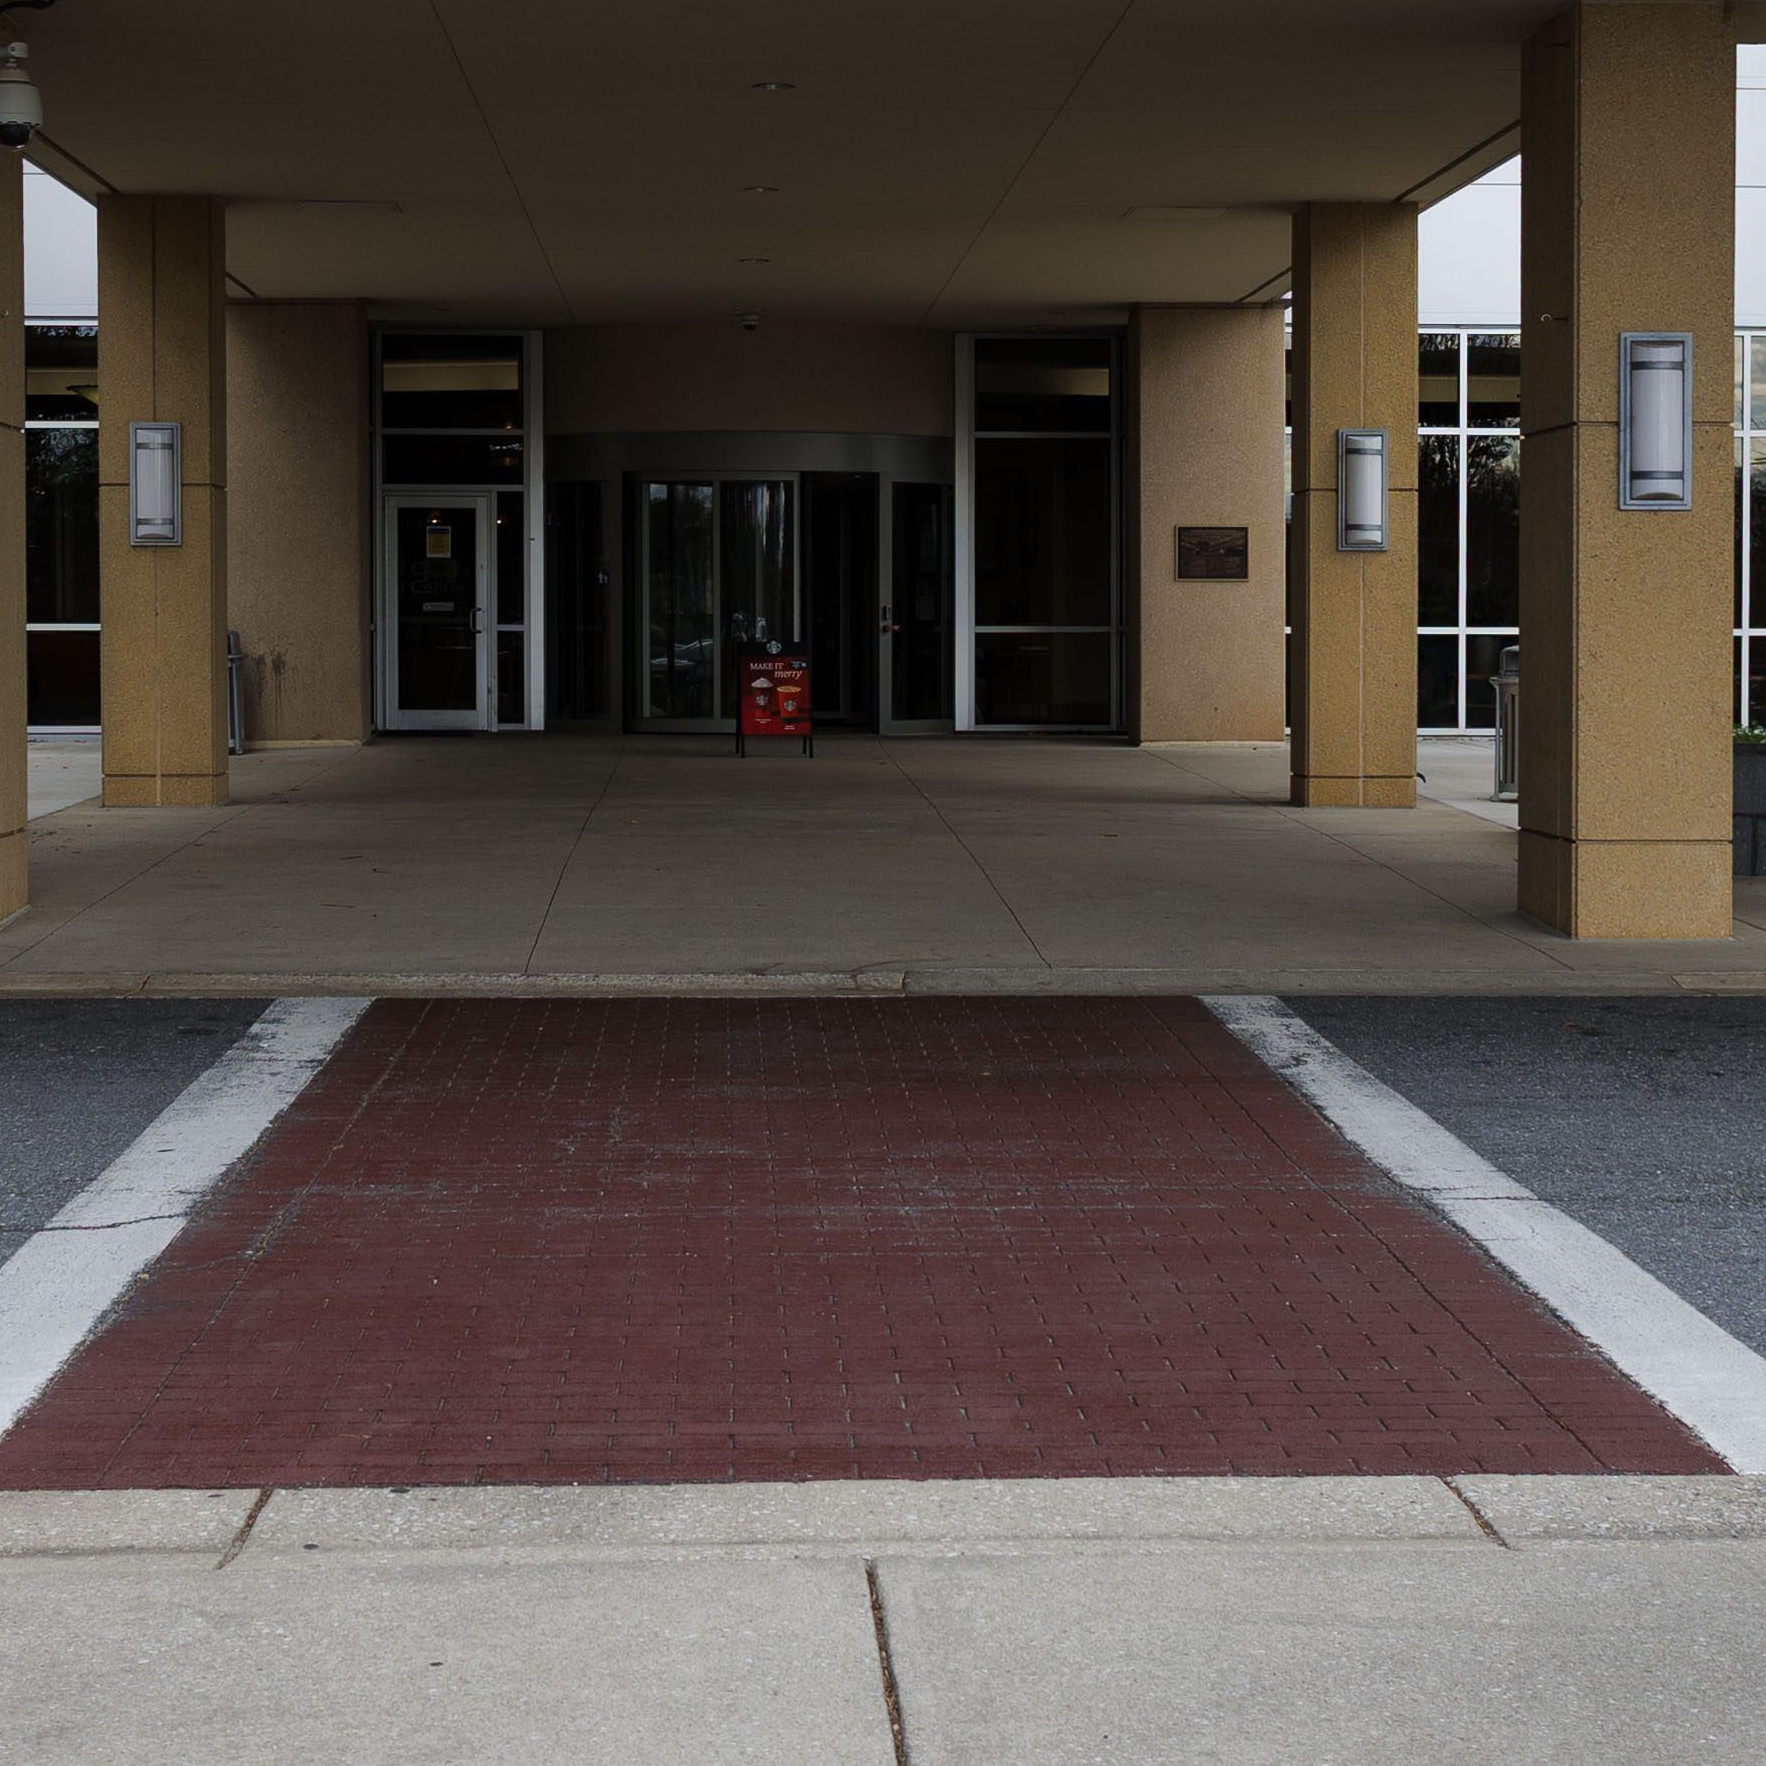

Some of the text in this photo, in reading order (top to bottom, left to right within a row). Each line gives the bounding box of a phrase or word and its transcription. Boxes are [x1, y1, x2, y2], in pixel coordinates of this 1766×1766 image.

[749, 662, 774, 670] MAKE
[774, 662, 784, 670] IT
[774, 670, 802, 679] merry
